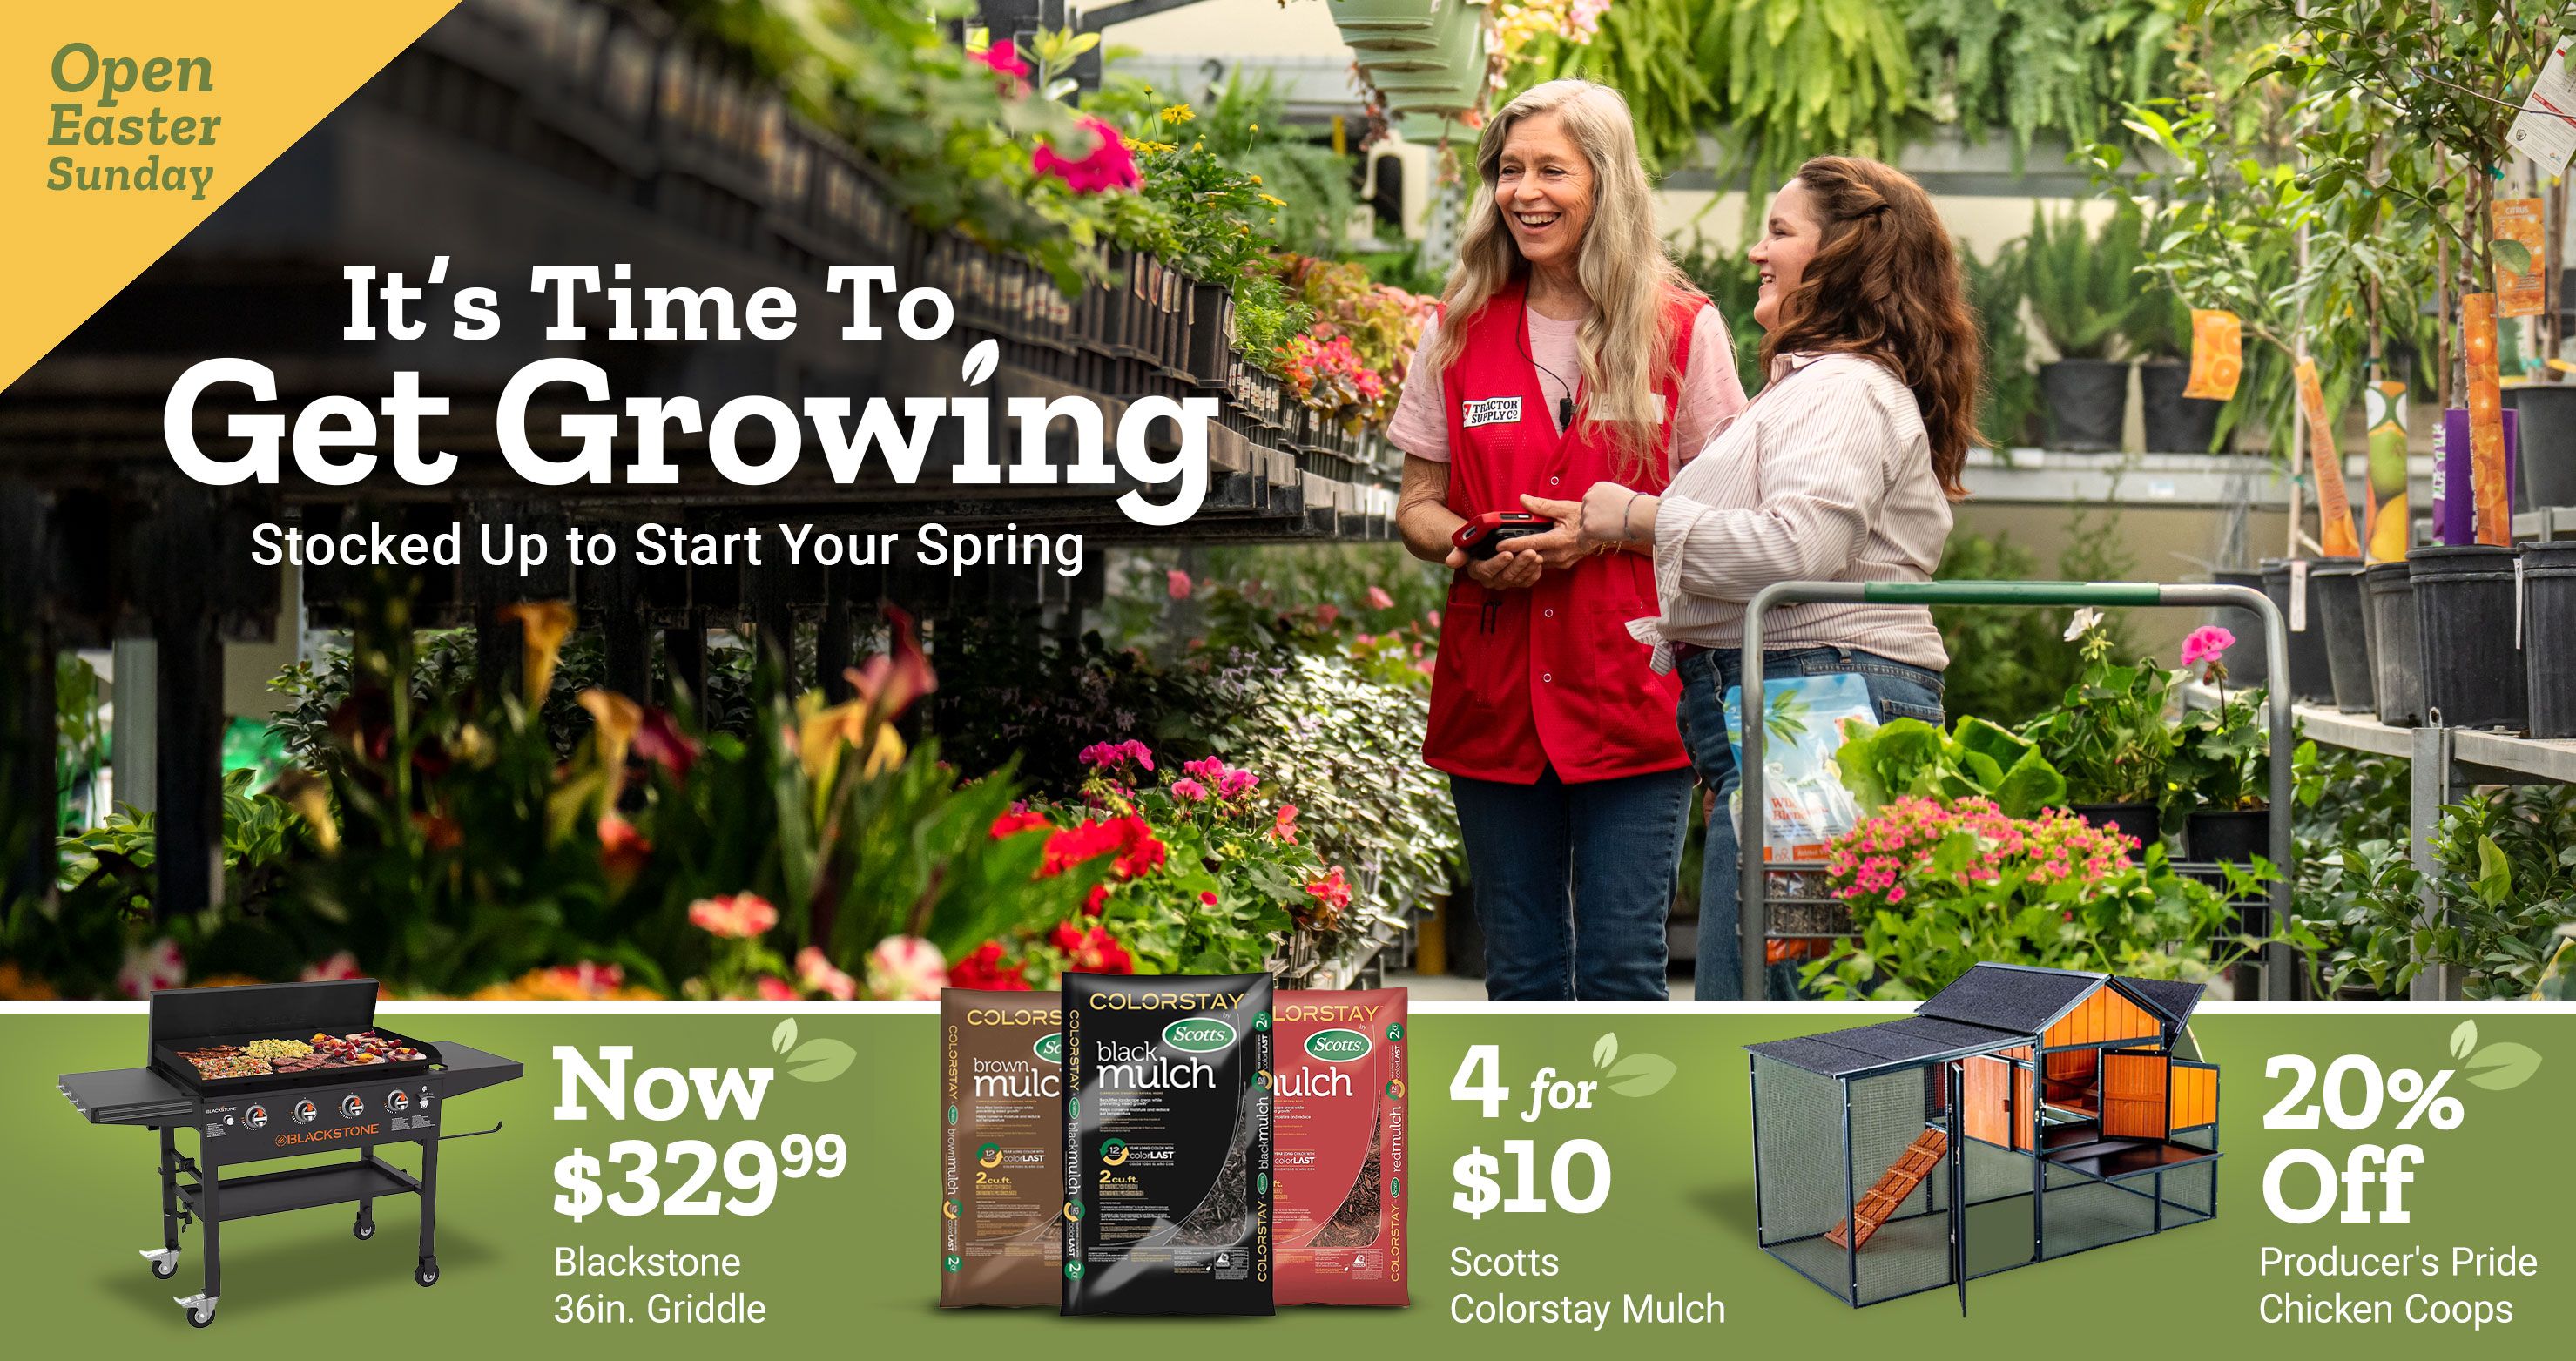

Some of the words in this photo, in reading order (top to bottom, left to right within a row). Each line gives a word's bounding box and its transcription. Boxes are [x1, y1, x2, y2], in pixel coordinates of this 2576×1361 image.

[1473, 400, 1518, 414] TRACTOR
[1471, 410, 1507, 424] SUPPLY
[1089, 992, 1244, 1011] COLORSTAY
[967, 1009, 1062, 1026] COLORS
[1222, 1012, 1231, 1021] by
[1273, 1005, 1379, 1021] LORSTAY
[1173, 1026, 1226, 1041] Scotts
[1069, 1009, 1080, 1091] COLORSTAY
[1096, 1041, 1158, 1061] black
[1314, 1037, 1362, 1052] Scotts
[948, 1025, 958, 1100] COLORSTAY
[974, 1057, 1029, 1073] brown
[1096, 1056, 1216, 1088] mulch
[973, 1068, 1062, 1098] mulc
[1274, 1066, 1352, 1097] ulch
[287, 1123, 380, 1144] BLACKSTONE
[1109, 1146, 1120, 1155] 12
[1257, 1201, 1267, 1283] COLORSTAY
[1391, 1204, 1400, 1282] COLORSTAY
